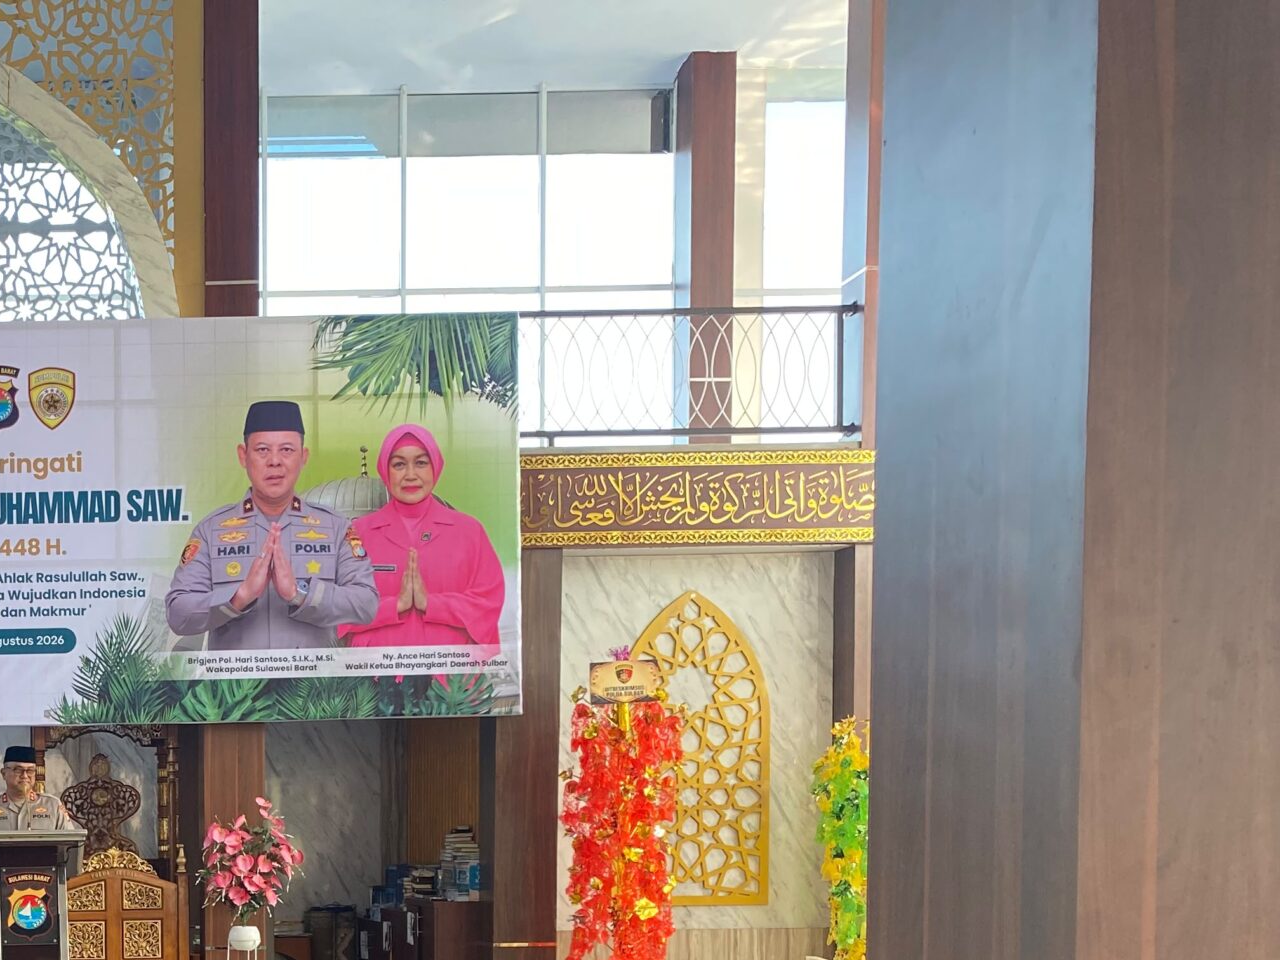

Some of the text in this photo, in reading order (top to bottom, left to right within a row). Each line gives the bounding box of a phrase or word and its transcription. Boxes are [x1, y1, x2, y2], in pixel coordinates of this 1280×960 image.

[127, 488, 189, 522] SAW.
[46, 538, 67, 555] H.
[217, 545, 250, 556] HARI
[295, 543, 331, 553] POLRI
[36, 571, 106, 583] Rasulullah
[109, 571, 145, 582] Saw.,
[8, 588, 76, 603] Wujudkan
[80, 586, 146, 599] Indonesia
[0, 606, 26, 617] dan
[29, 605, 86, 617] Makmur
[36, 635, 65, 645] 2026
[187, 656, 217, 666] Brigjen
[254, 655, 290, 664] Santoso,
[397, 652, 418, 660] Ance
[437, 651, 470, 659] Santoso
[205, 665, 254, 674] Wakapolda
[255, 664, 292, 672] Sulawesi
[345, 662, 368, 670] Wakil
[395, 661, 447, 670] Bhayangkari
[450, 660, 480, 668] Daerah
